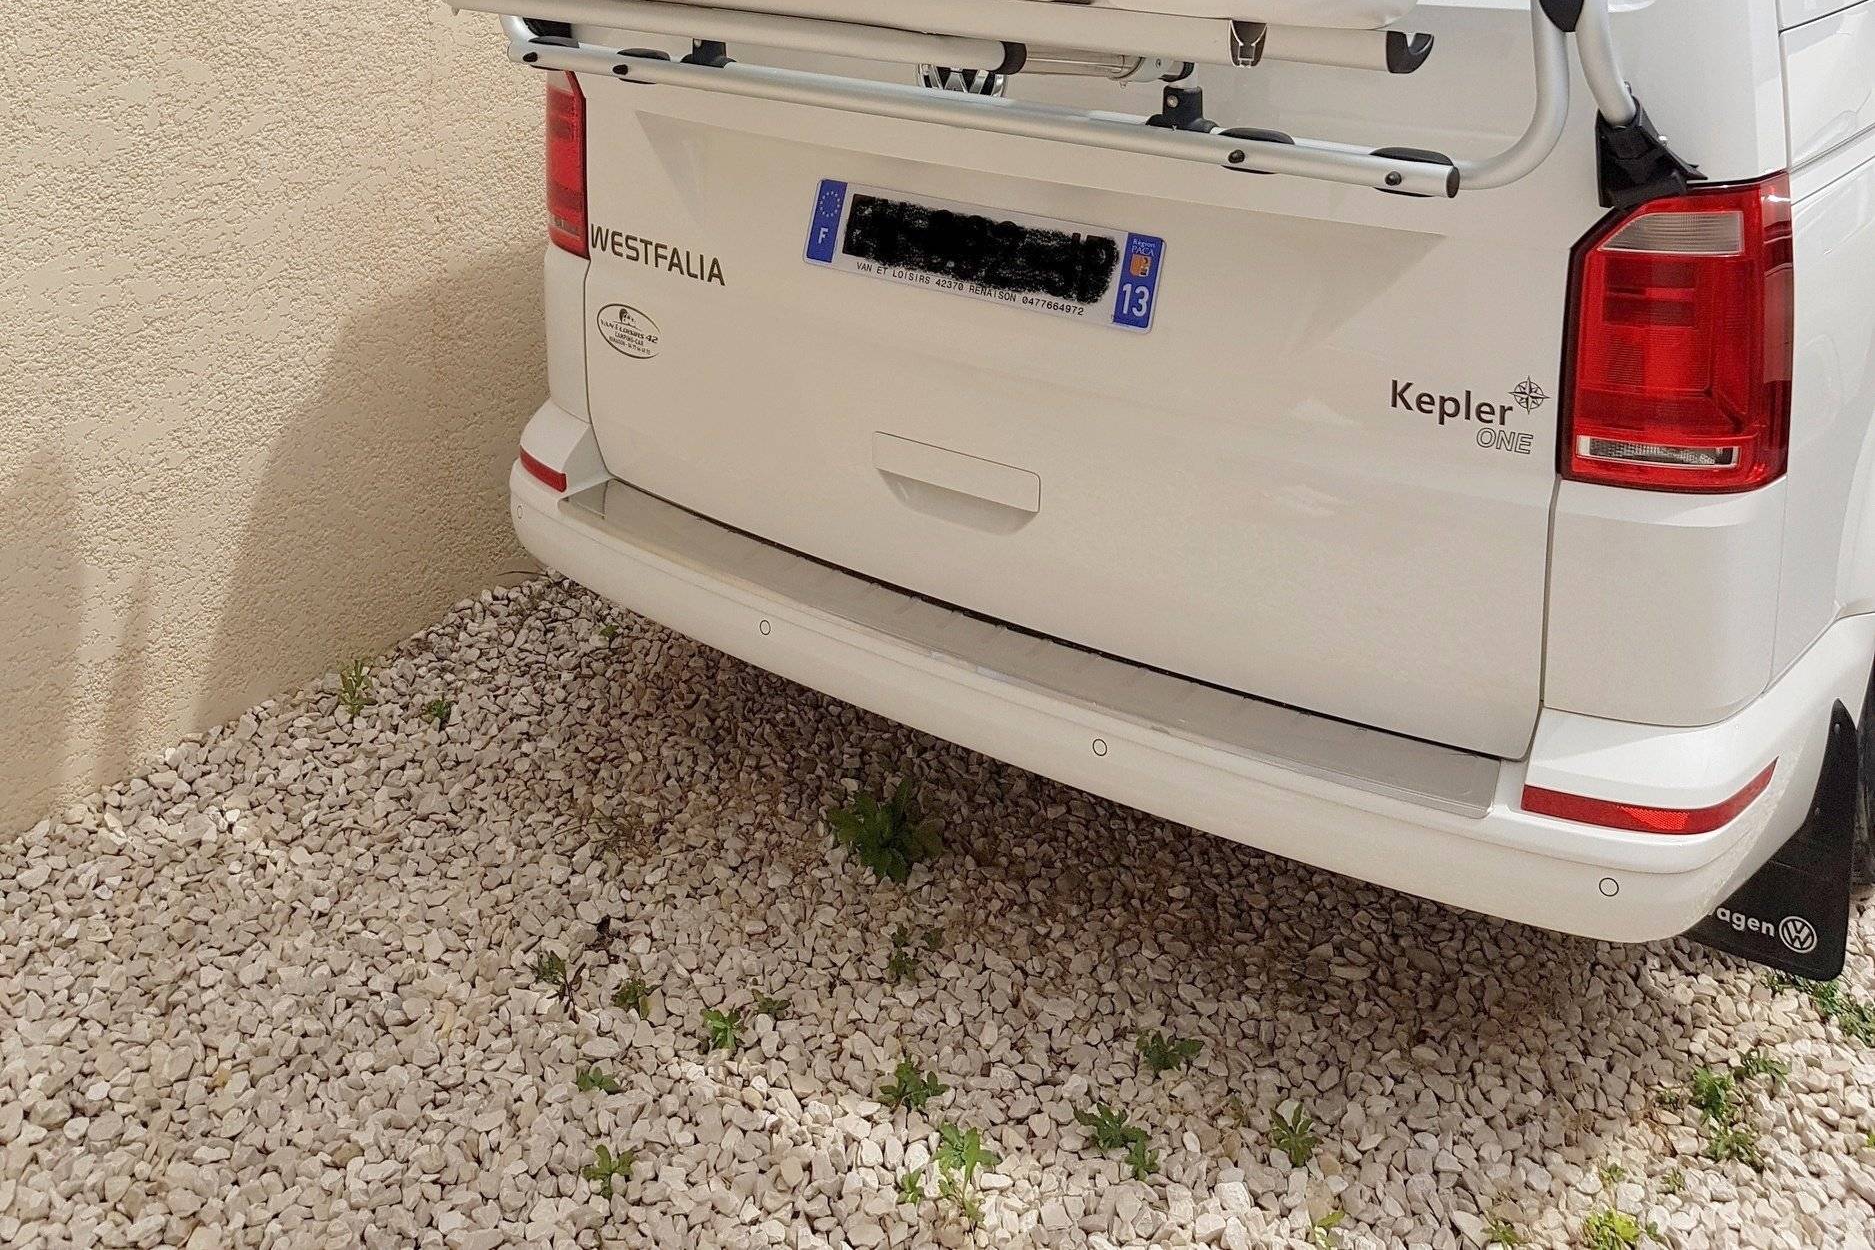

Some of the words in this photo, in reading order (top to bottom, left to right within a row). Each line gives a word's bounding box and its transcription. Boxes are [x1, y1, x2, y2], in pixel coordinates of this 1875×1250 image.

[817, 226, 829, 244] F
[590, 223, 726, 287] WESTFALIA
[856, 261, 873, 272] VAN
[876, 266, 889, 276] ET
[892, 269, 931, 285] LOISIRS
[935, 278, 964, 291] 42370
[969, 284, 1017, 303] RENAISON
[1021, 295, 1085, 316] 0477664972
[1121, 283, 1150, 317] 13
[645, 334, 659, 344] 42
[1391, 379, 1513, 426] Kepler
[1476, 427, 1534, 455] ONE
[1709, 907, 1775, 938] agen
